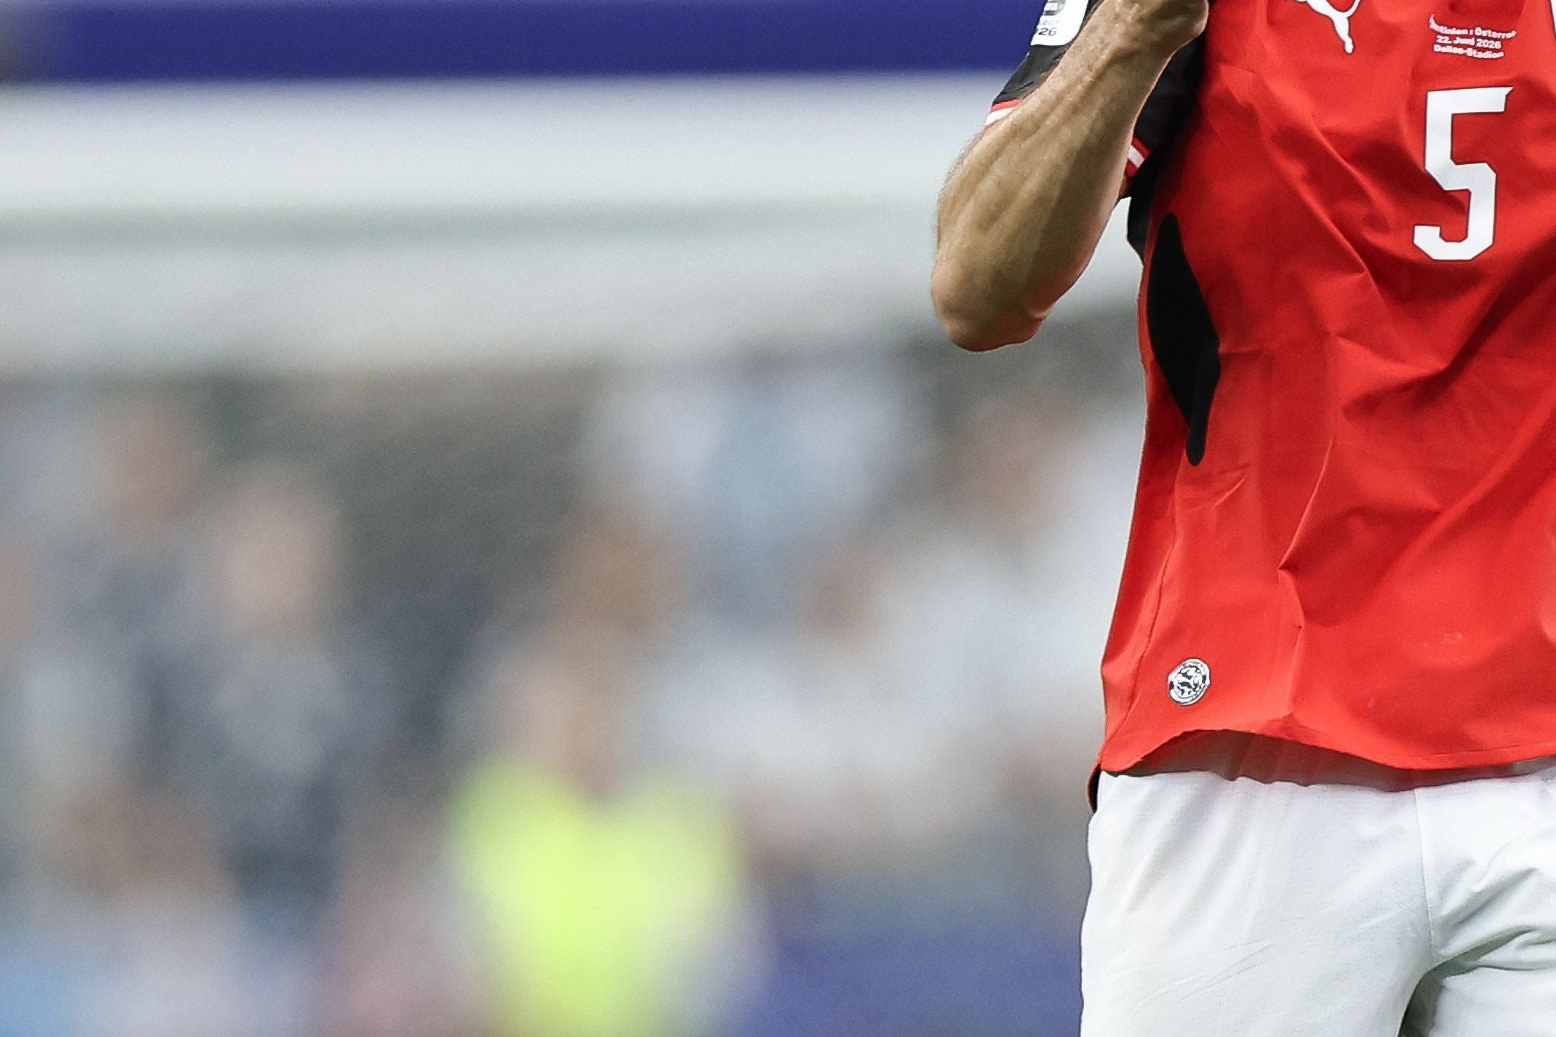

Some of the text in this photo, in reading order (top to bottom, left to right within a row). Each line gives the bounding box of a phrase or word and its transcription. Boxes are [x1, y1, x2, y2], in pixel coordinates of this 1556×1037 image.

[1436, 35, 1502, 50] 22. Juni 2026
[1433, 44, 1505, 59] Dallas-Stadion
[1413, 86, 1514, 261] 5
